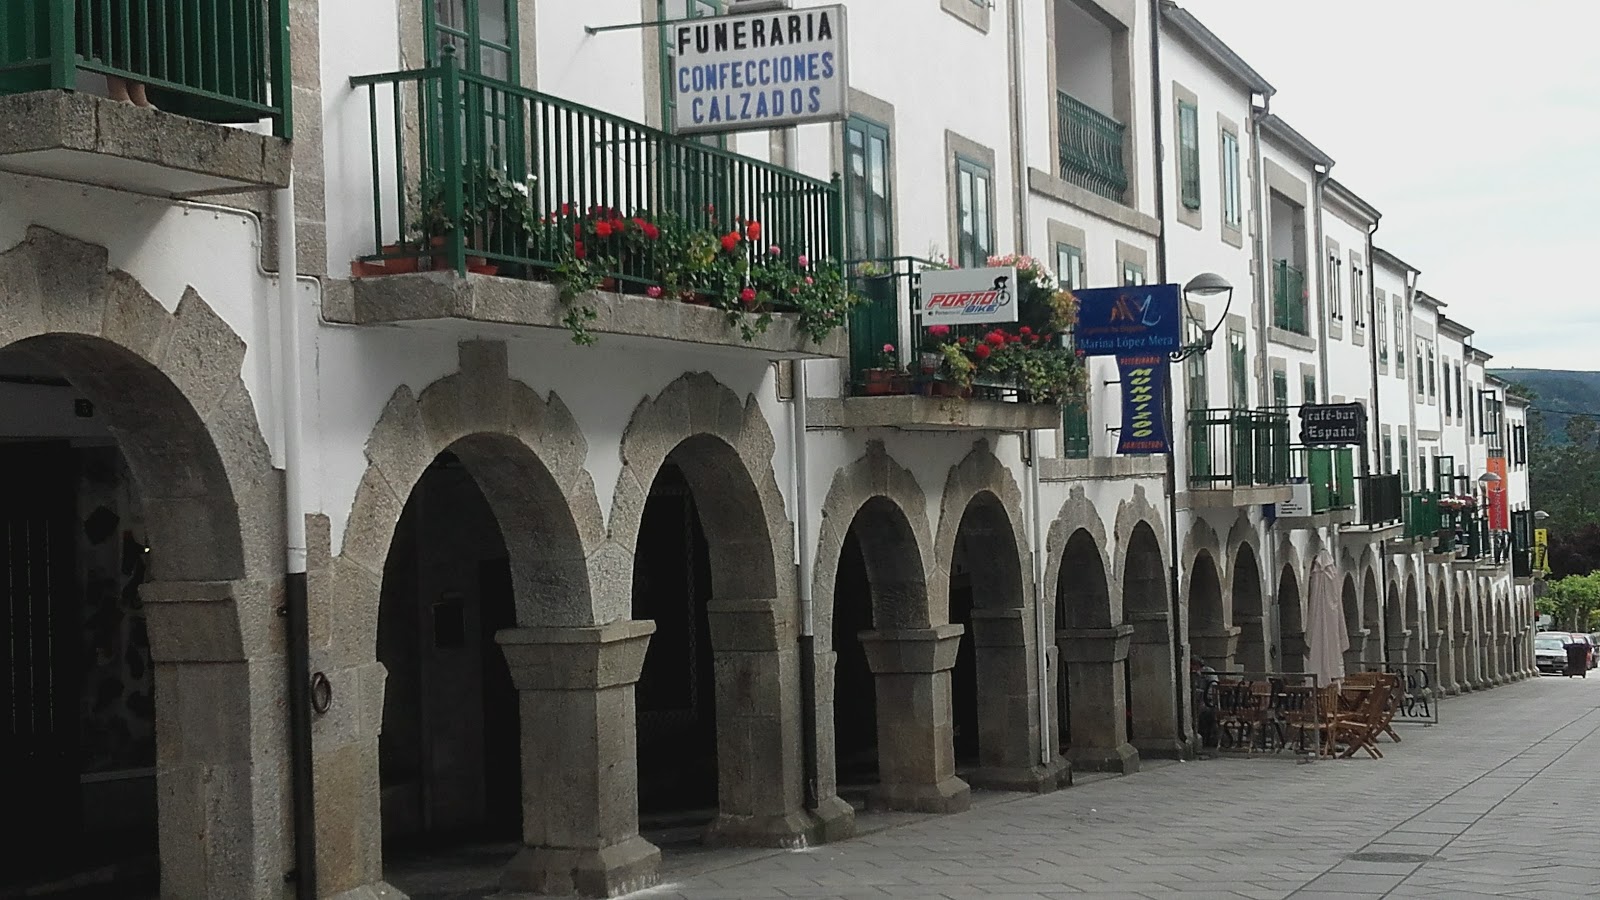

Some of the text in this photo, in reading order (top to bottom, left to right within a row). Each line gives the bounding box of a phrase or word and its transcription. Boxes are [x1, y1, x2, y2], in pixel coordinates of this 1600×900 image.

[678, 12, 832, 56] FUNERARIA
[678, 51, 834, 93] CONFECCIONES
[692, 86, 821, 124] CALZADOS
[927, 292, 997, 308] PORTO
[963, 304, 998, 313] BIKE
[1080, 335, 1173, 349] Marina López Mera
[1128, 368, 1153, 438] MUNDIZOO
[1308, 410, 1355, 421] café-bar
[1308, 425, 1355, 440] España
